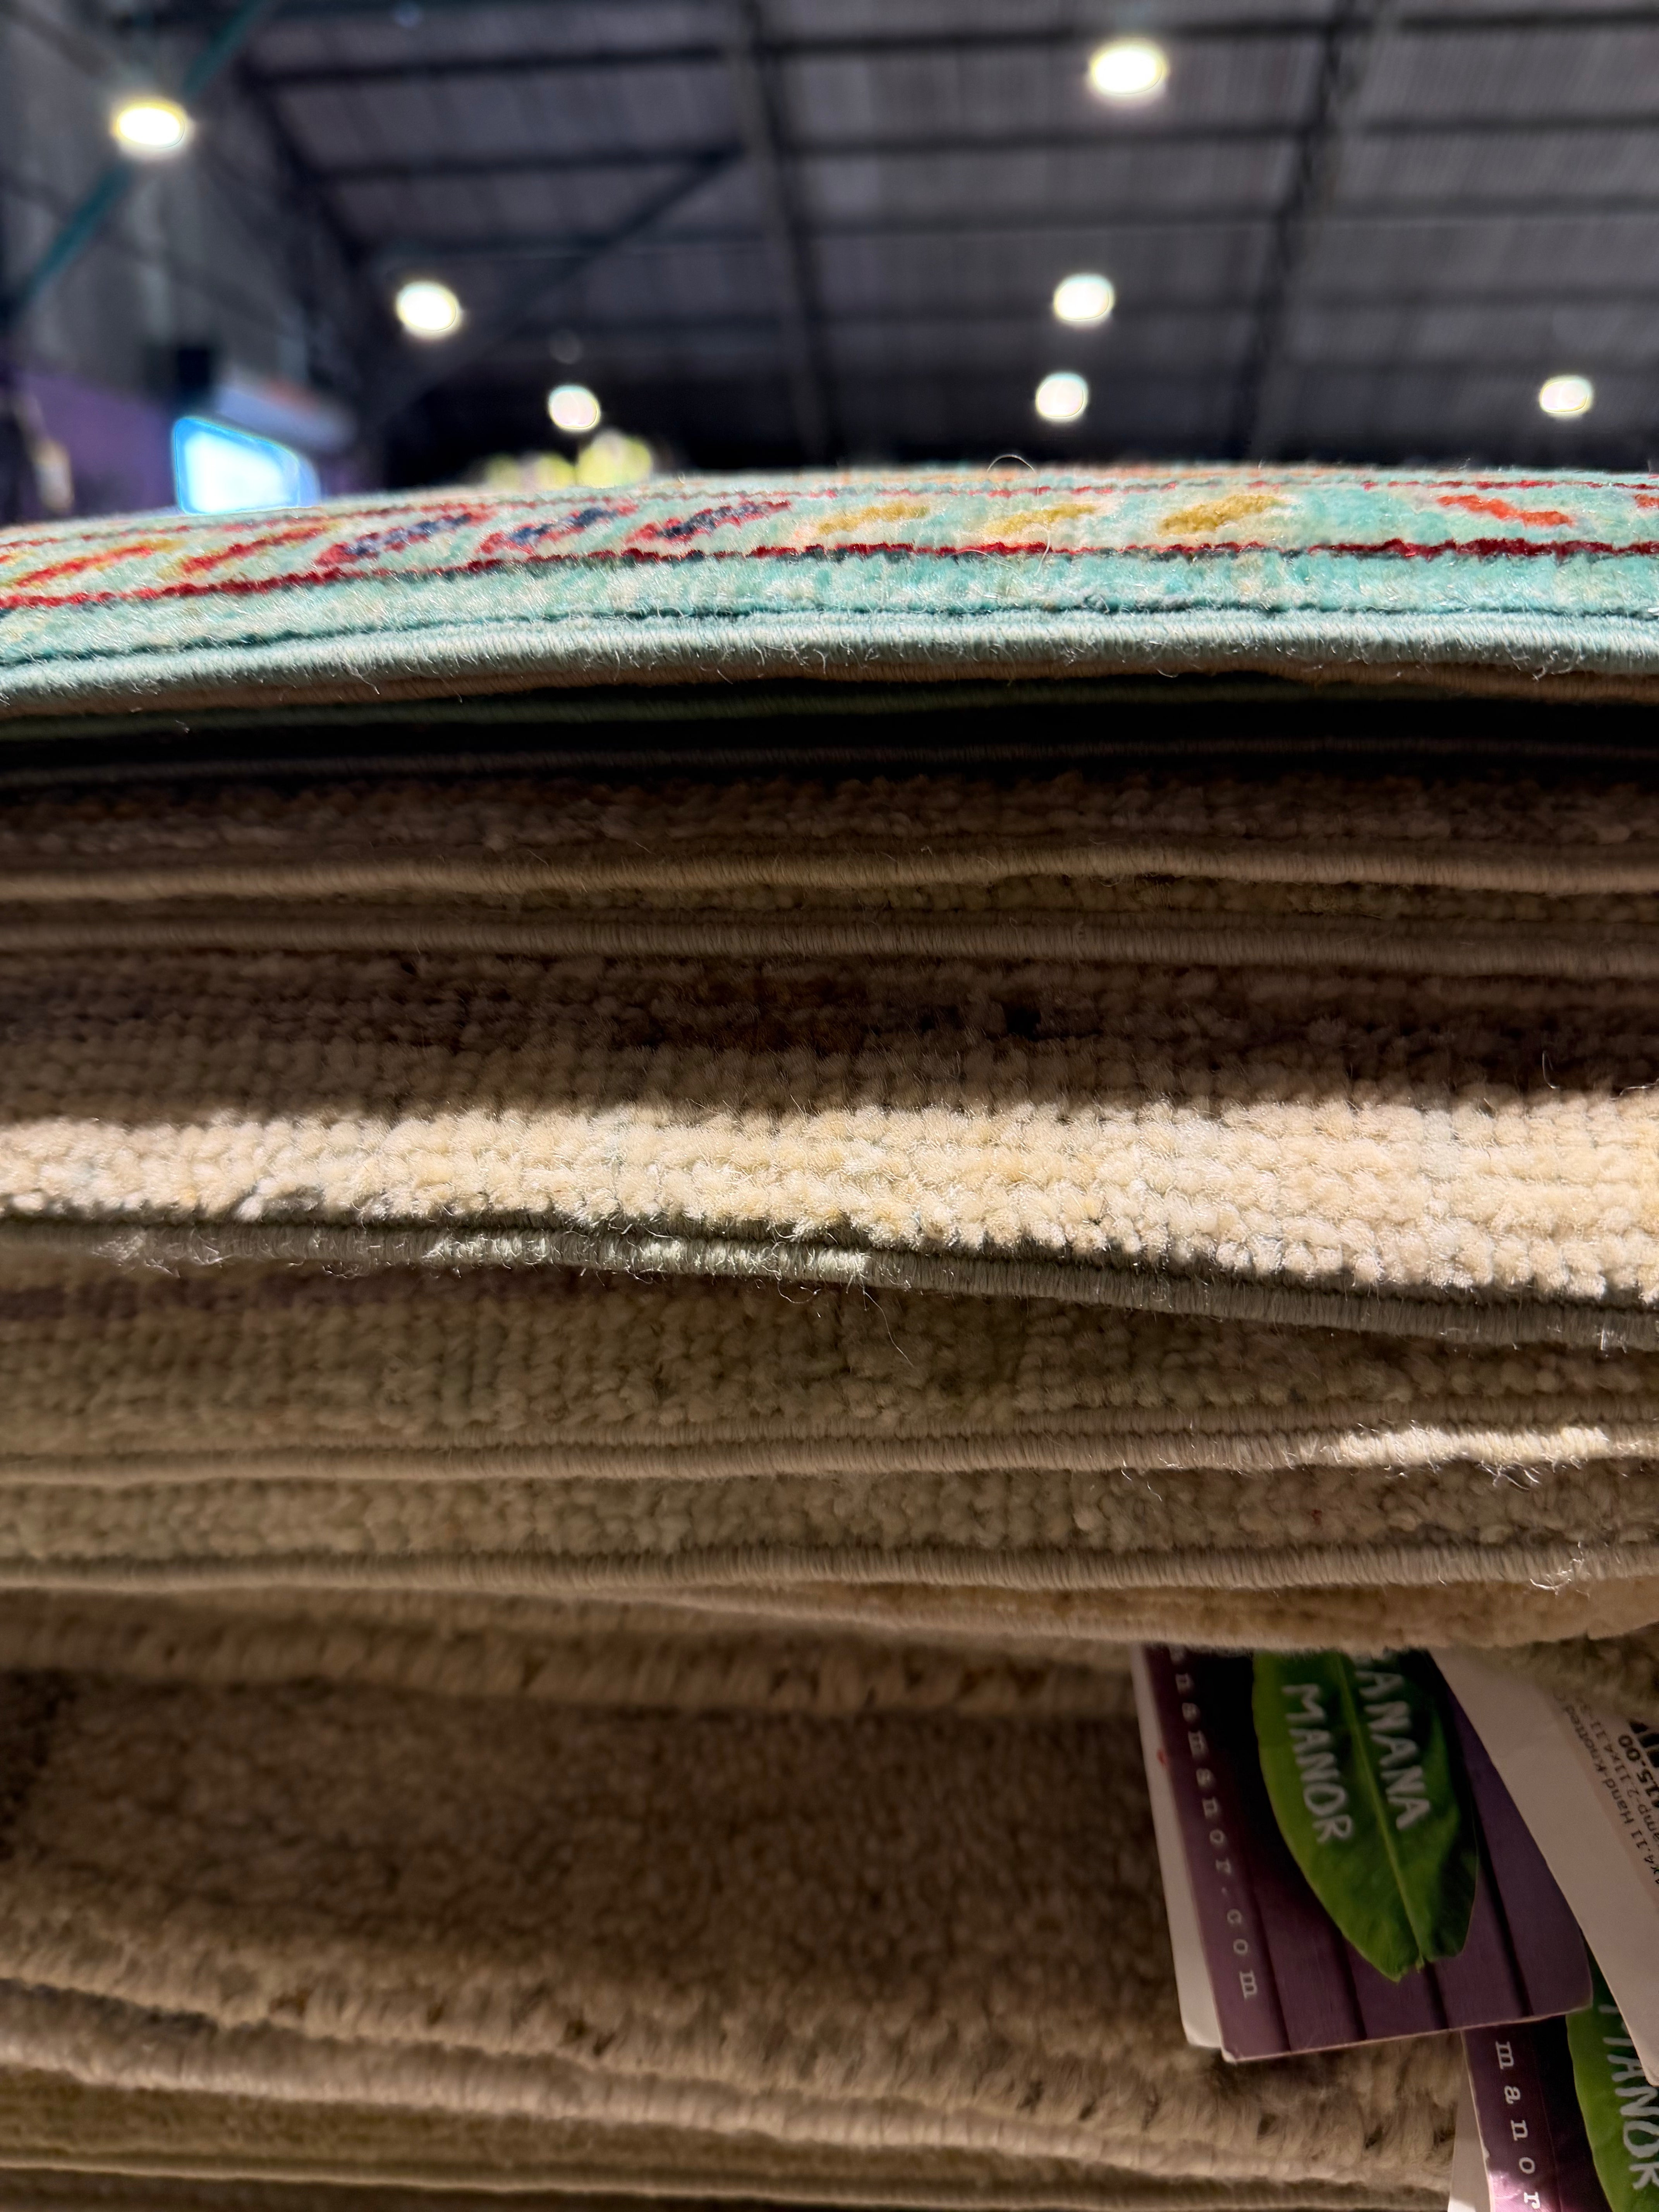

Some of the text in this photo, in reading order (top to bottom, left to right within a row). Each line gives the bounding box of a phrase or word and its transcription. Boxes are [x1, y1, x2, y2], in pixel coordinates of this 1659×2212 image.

[1281, 1683, 1353, 1844] MANOR
[1355, 1651, 1431, 1830] ANANA
[1565, 1705, 1634, 1824] Hand-Knotted
[1495, 2040, 1541, 2209] manor
